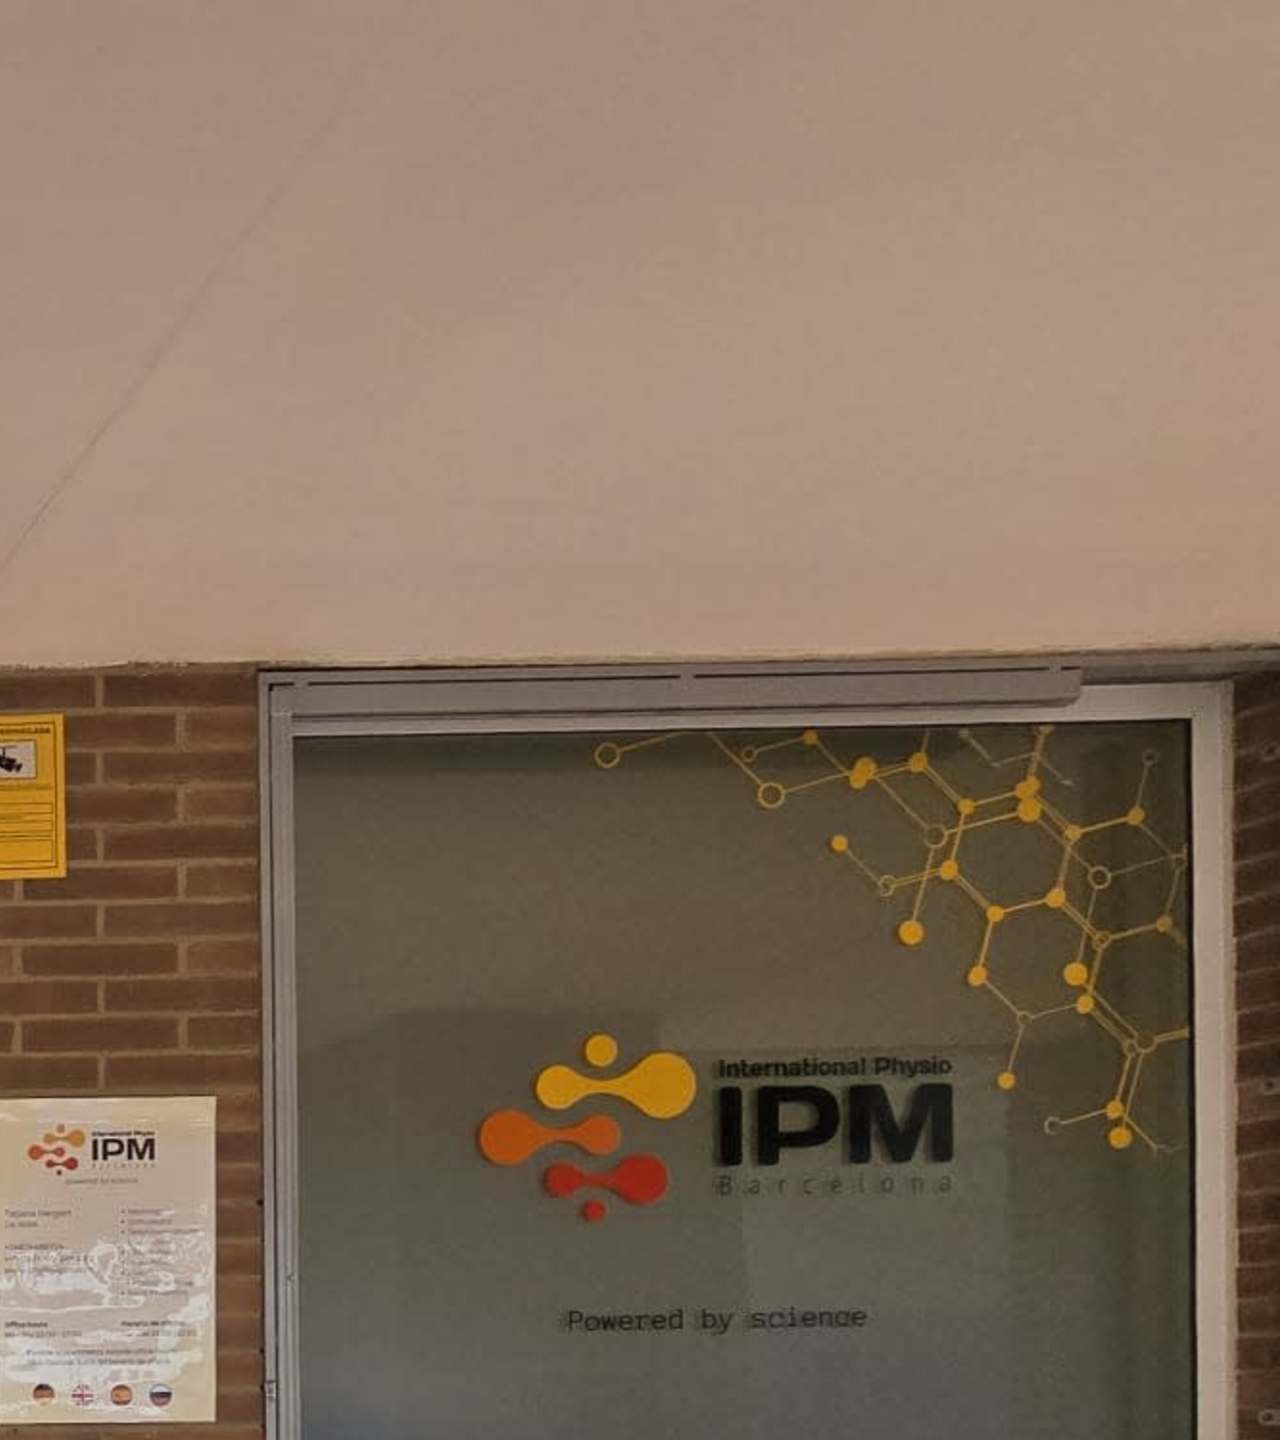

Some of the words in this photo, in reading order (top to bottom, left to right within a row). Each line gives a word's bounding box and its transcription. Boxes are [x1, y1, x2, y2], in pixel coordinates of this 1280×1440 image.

[718, 1059, 867, 1078] International
[874, 1057, 952, 1078] Physio
[719, 1083, 954, 1166] IPM
[92, 1138, 156, 1161] IPM
[720, 1174, 952, 1196] Barcelona
[568, 1308, 684, 1332] Powered
[701, 1308, 733, 1335] by
[752, 1306, 868, 1330] science
